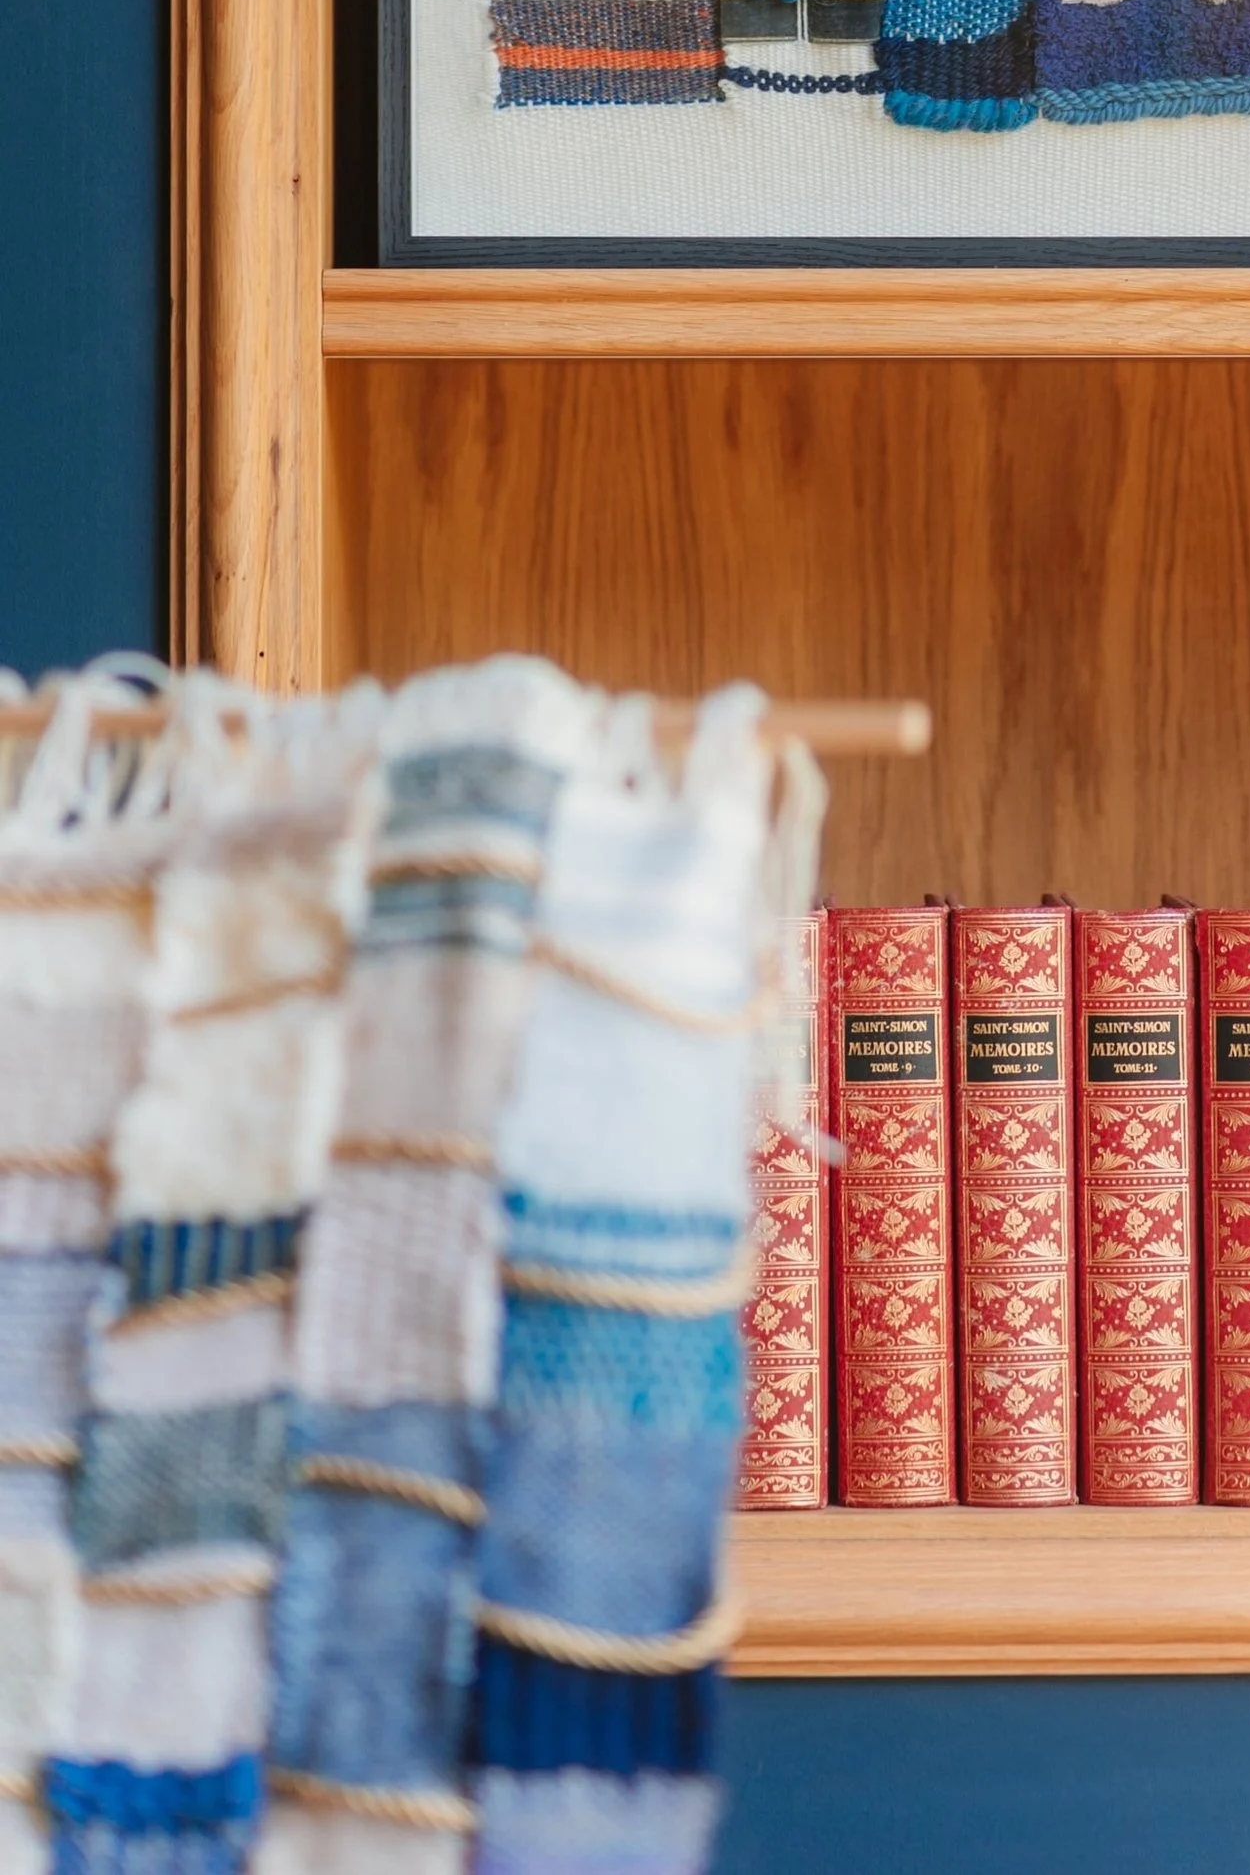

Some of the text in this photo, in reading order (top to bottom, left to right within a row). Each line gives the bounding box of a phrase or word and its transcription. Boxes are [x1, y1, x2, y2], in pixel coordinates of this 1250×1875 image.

[852, 1020, 927, 1032] SAINT-SIMON
[973, 1021, 1049, 1034] SAINT-SIMON
[1095, 1021, 1171, 1033] SAINT-SIMON
[848, 1040, 932, 1055] MEMOIRES
[970, 1041, 1055, 1057] MEMOIRES
[1091, 1041, 1176, 1056] MEMOIRES
